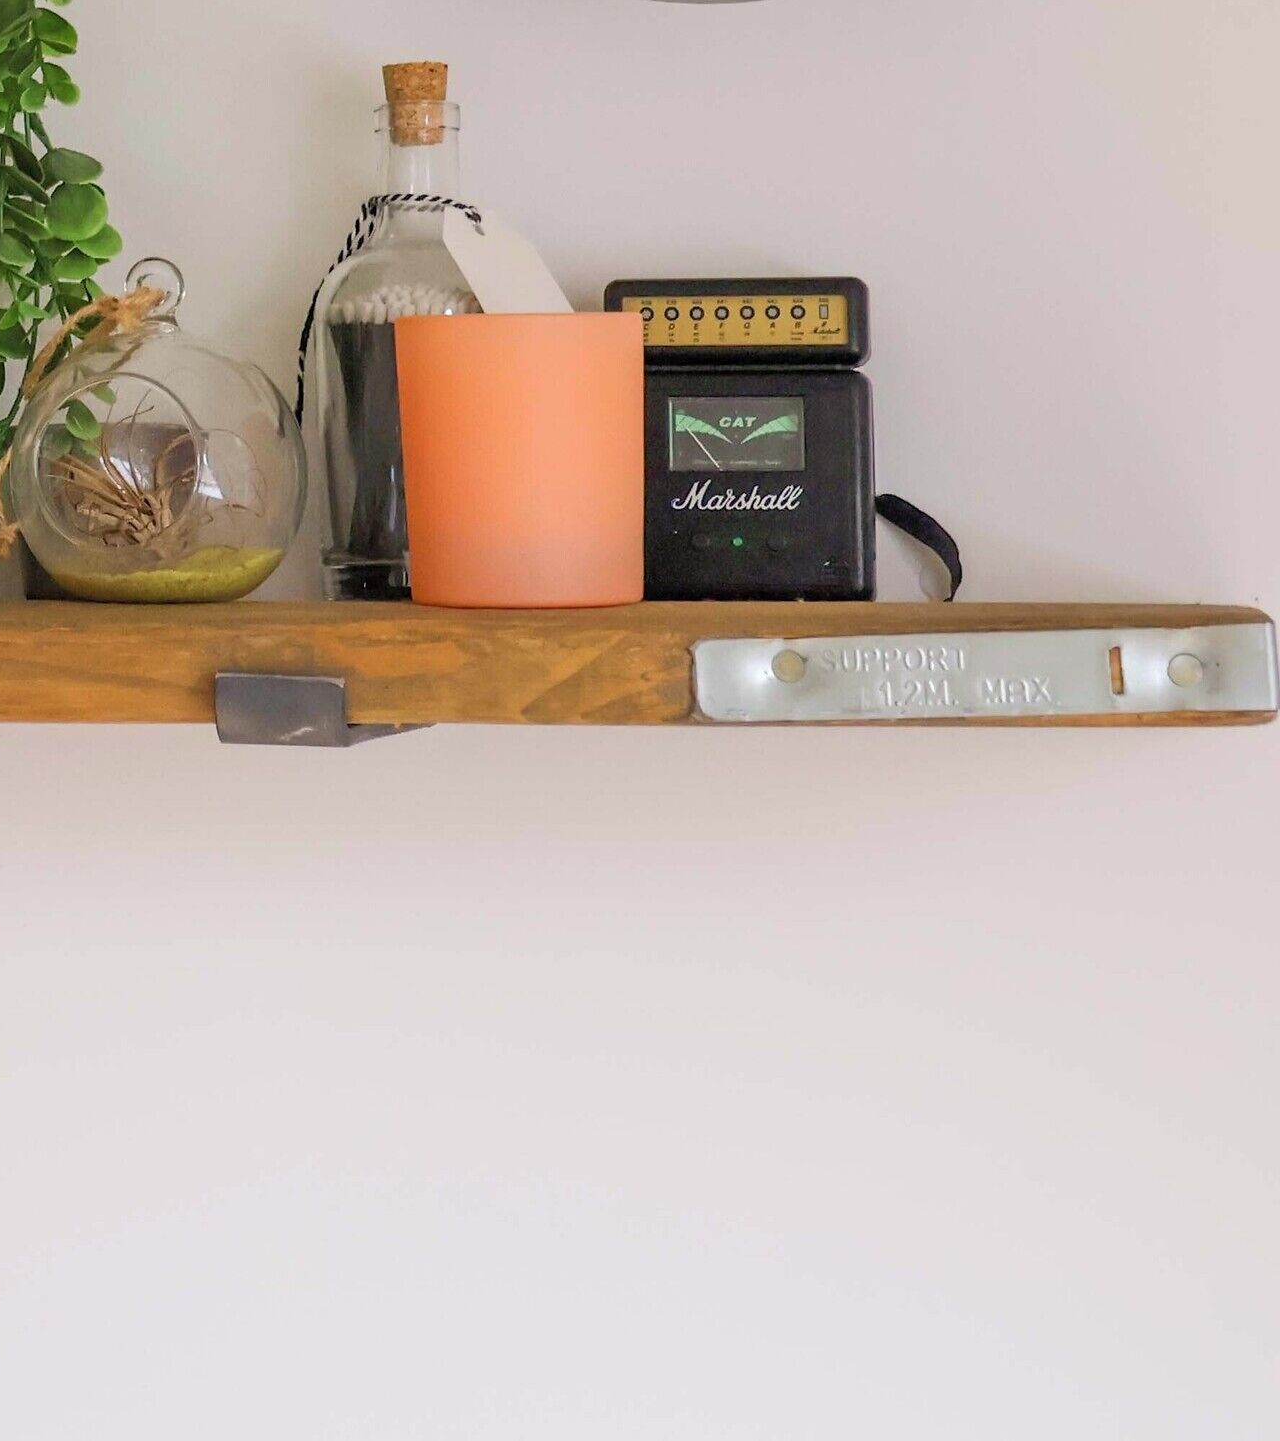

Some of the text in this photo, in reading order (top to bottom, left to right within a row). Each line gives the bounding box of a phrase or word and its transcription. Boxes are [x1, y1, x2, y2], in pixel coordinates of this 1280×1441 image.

[719, 416, 757, 428] CAT
[671, 479, 804, 510] Marshall
[822, 646, 966, 673] SUPPORT
